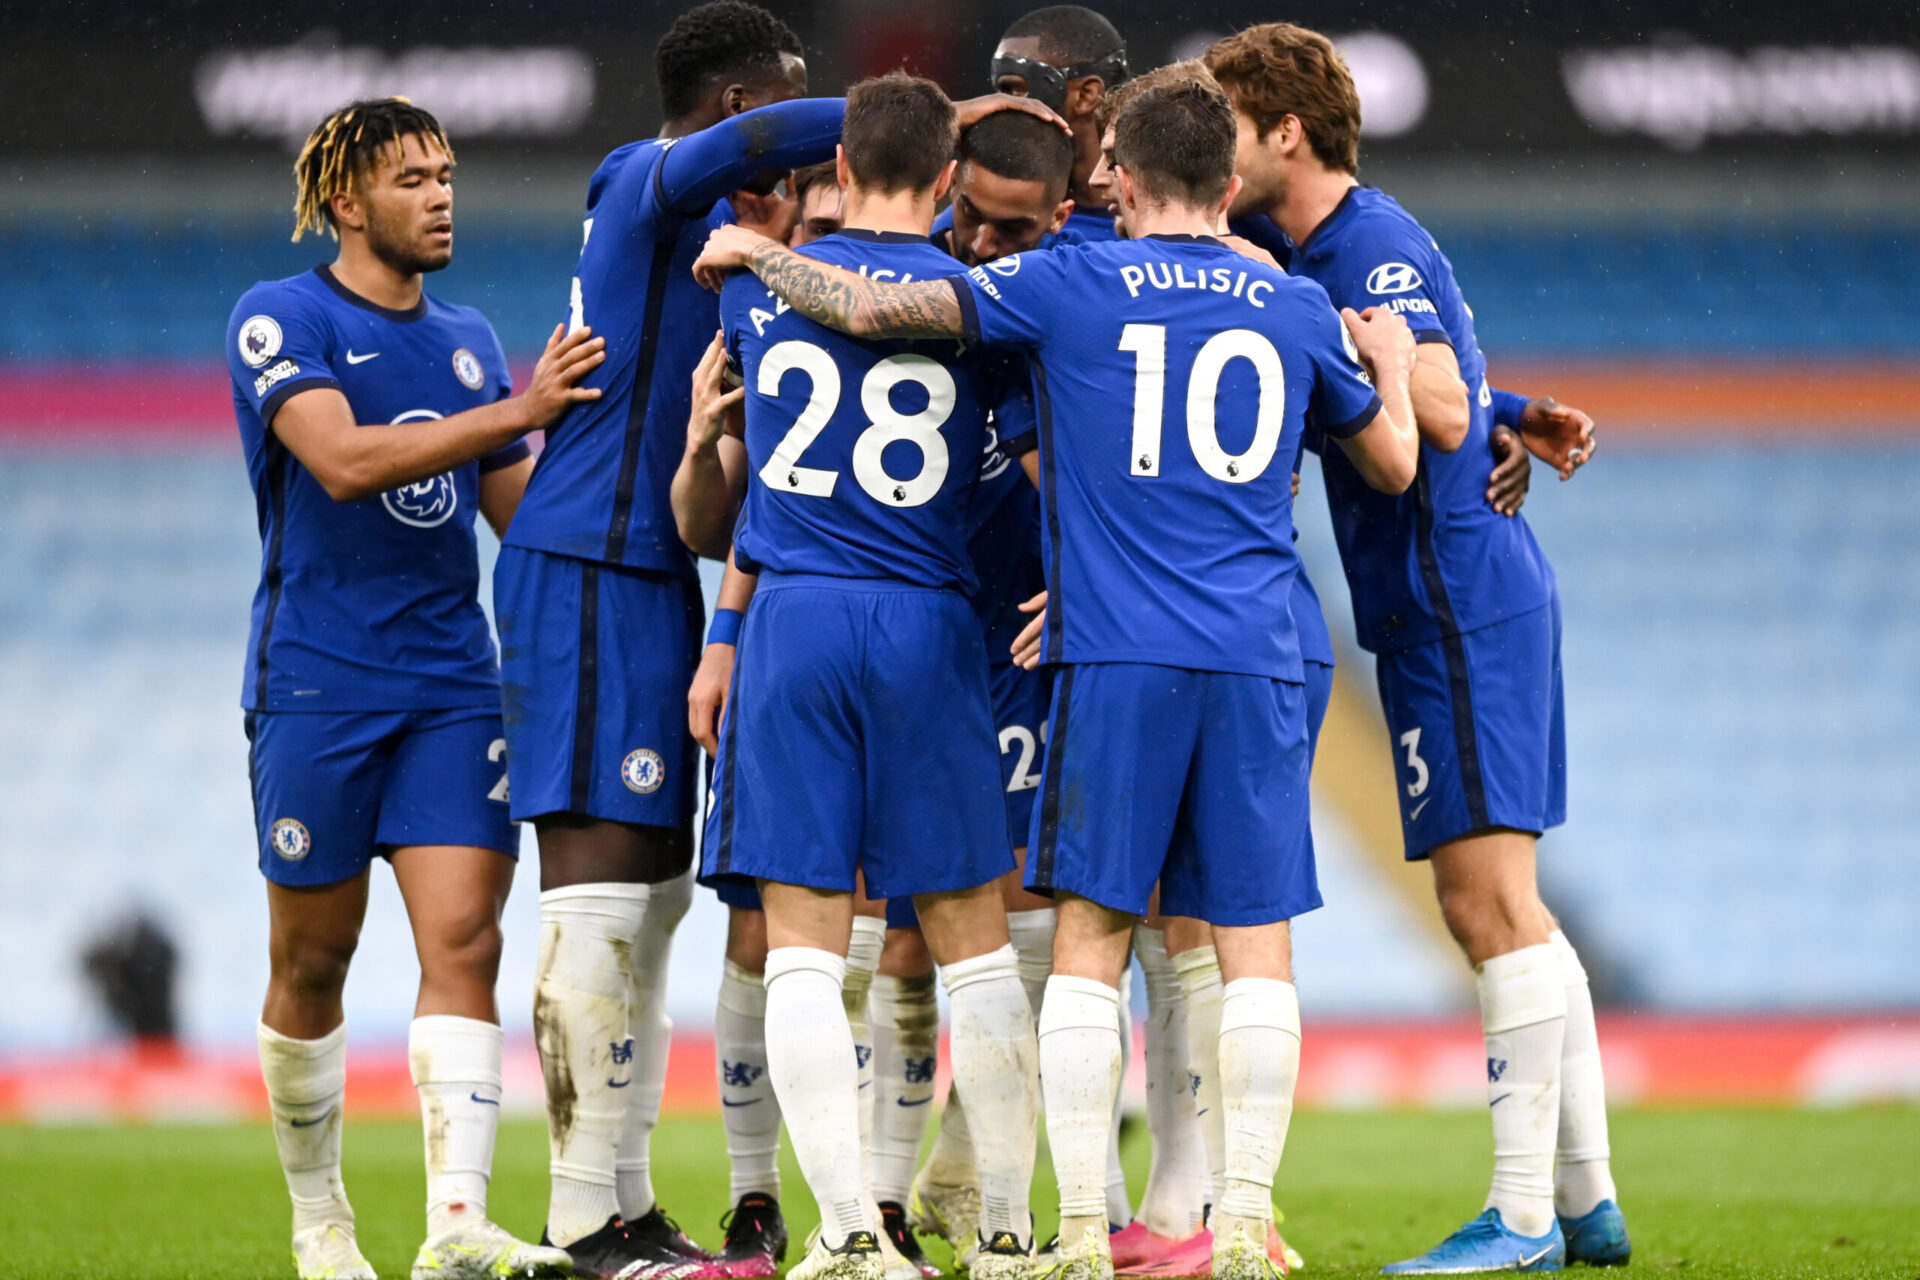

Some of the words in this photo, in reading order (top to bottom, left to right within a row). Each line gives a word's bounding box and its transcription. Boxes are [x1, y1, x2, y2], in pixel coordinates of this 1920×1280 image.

[1119, 262, 1275, 308] PULISIC
[1380, 298, 1438, 315] UNDA
[757, 340, 957, 508] 28
[1117, 322, 1286, 485] 10
[998, 720, 1049, 792] 2
[1400, 727, 1429, 798] 3
